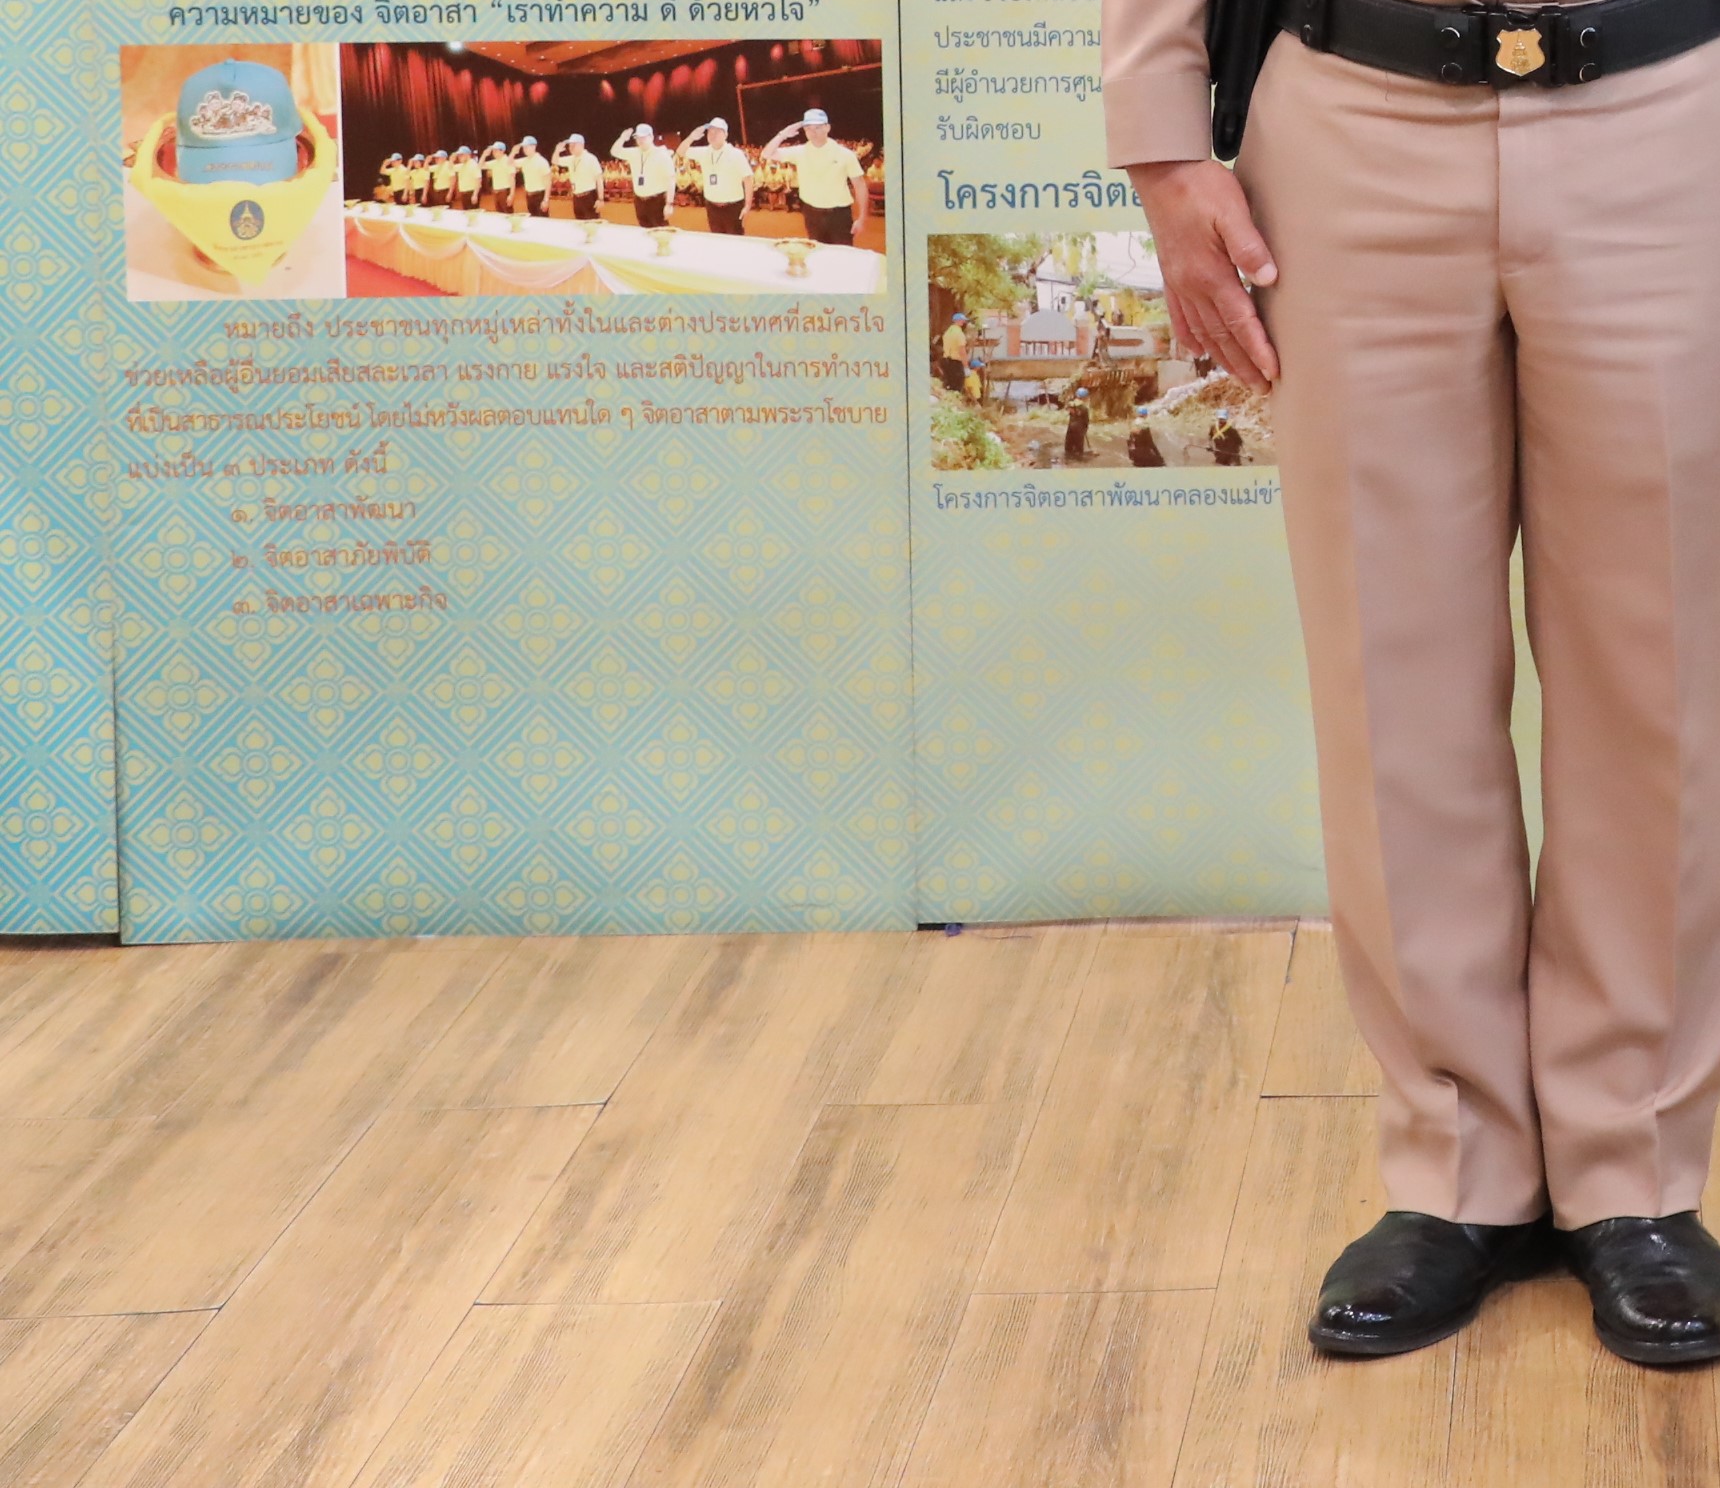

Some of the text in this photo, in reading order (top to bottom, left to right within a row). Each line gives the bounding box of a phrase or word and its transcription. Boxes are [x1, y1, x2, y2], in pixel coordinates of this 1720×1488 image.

[169, 1, 364, 31] ความหมายของ
[934, 22, 1102, 49] ประชาชนมีความ
[936, 118, 1042, 142] รับผิดชอบ
[224, 301, 885, 345] หมายถึง ประชาชนทุกหมู่เหล่าทั้งในและต่างประเทศที่สมัครใจ
[124, 352, 889, 394] ช่วยเหลือผู้อื่นยอมเสียสละเวลา แรงกาย แรงใจ และสติปัญญาในการทำงาน
[126, 397, 888, 433] ที่เป็นสาธารณประโยชน์ โดยไม่หวังผลตอบแทนใด ๆ จิตอาสาตามพระราโชบาย
[128, 451, 213, 480] แบ่งเป็น
[250, 454, 336, 477] ประเภท
[344, 440, 391, 476] ดังนี้
[263, 496, 417, 523] จิตอาสาพัฒนา
[934, 479, 1281, 510] โครงการจิตอาสาพัฒนาคลองแม่ข่
[263, 540, 432, 568] จิตอาสาภัยพิบัติ
[264, 585, 448, 613] จิตอาสาเฉพาะกิจ
